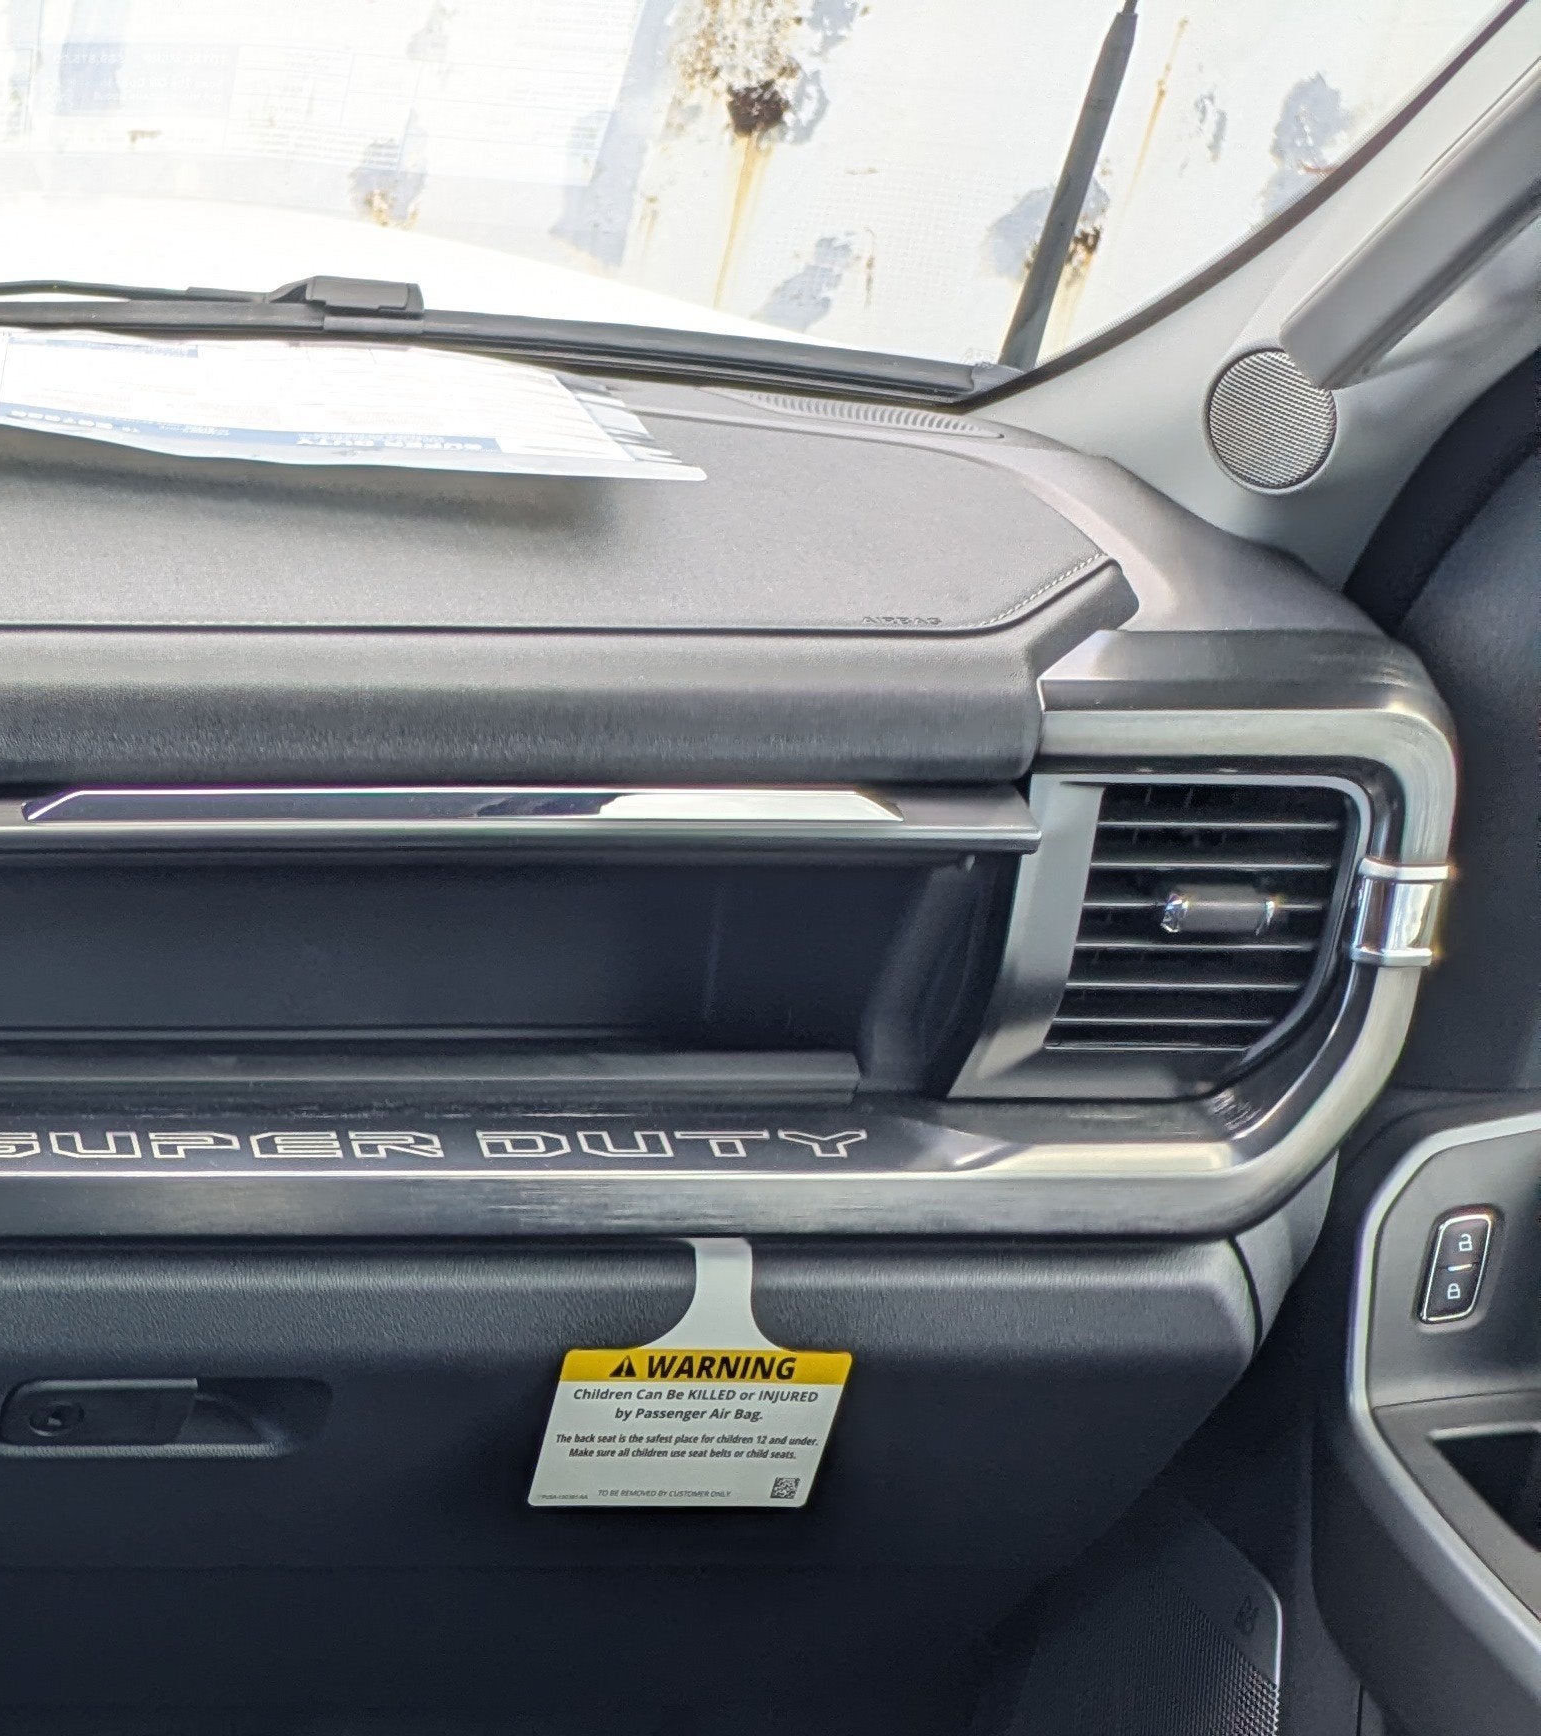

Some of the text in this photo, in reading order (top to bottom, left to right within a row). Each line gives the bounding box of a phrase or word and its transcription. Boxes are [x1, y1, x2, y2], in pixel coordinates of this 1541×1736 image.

[480, 1130, 868, 1160] DUTY
[648, 1355, 797, 1380] WARNING
[573, 1388, 819, 1403] Children Can Be KILLED or INJURED
[614, 1407, 763, 1422] by Passenger Air Bag.
[556, 1434, 818, 1446] The back seat is the safest place for children 12 and under.
[569, 1447, 797, 1459] Make sure all children use seat belts or child seats.
